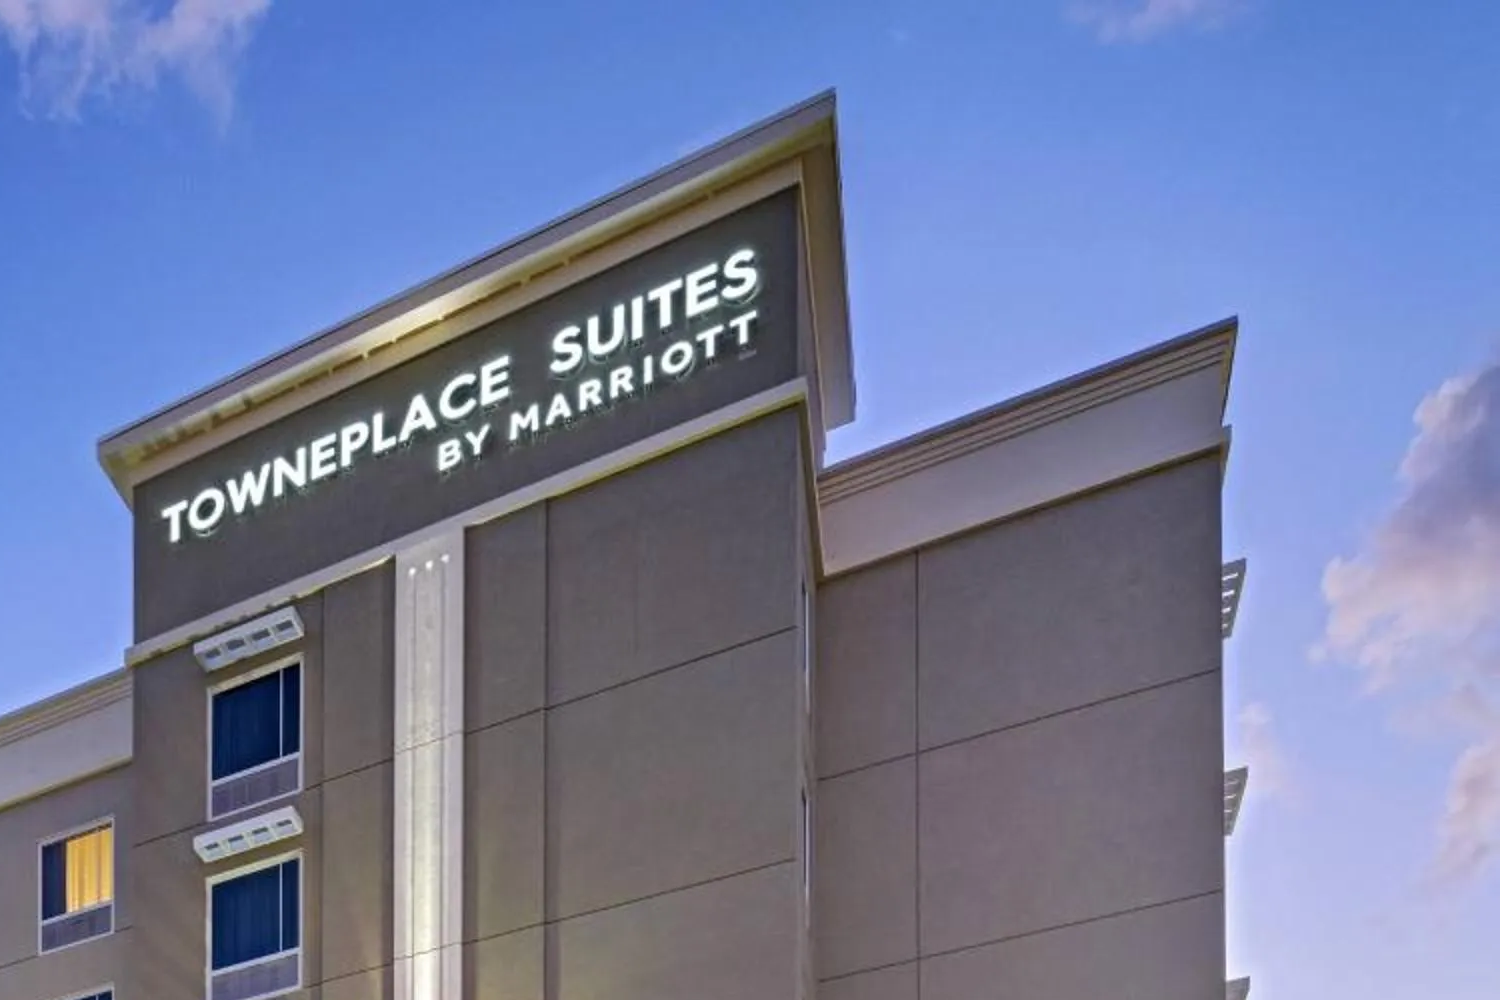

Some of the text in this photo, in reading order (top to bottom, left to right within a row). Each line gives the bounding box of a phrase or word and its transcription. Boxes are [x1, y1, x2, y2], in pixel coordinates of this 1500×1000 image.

[161, 249, 758, 543] TOWNEPLACE SUITES
[437, 310, 758, 472] BY MARRIOTT
